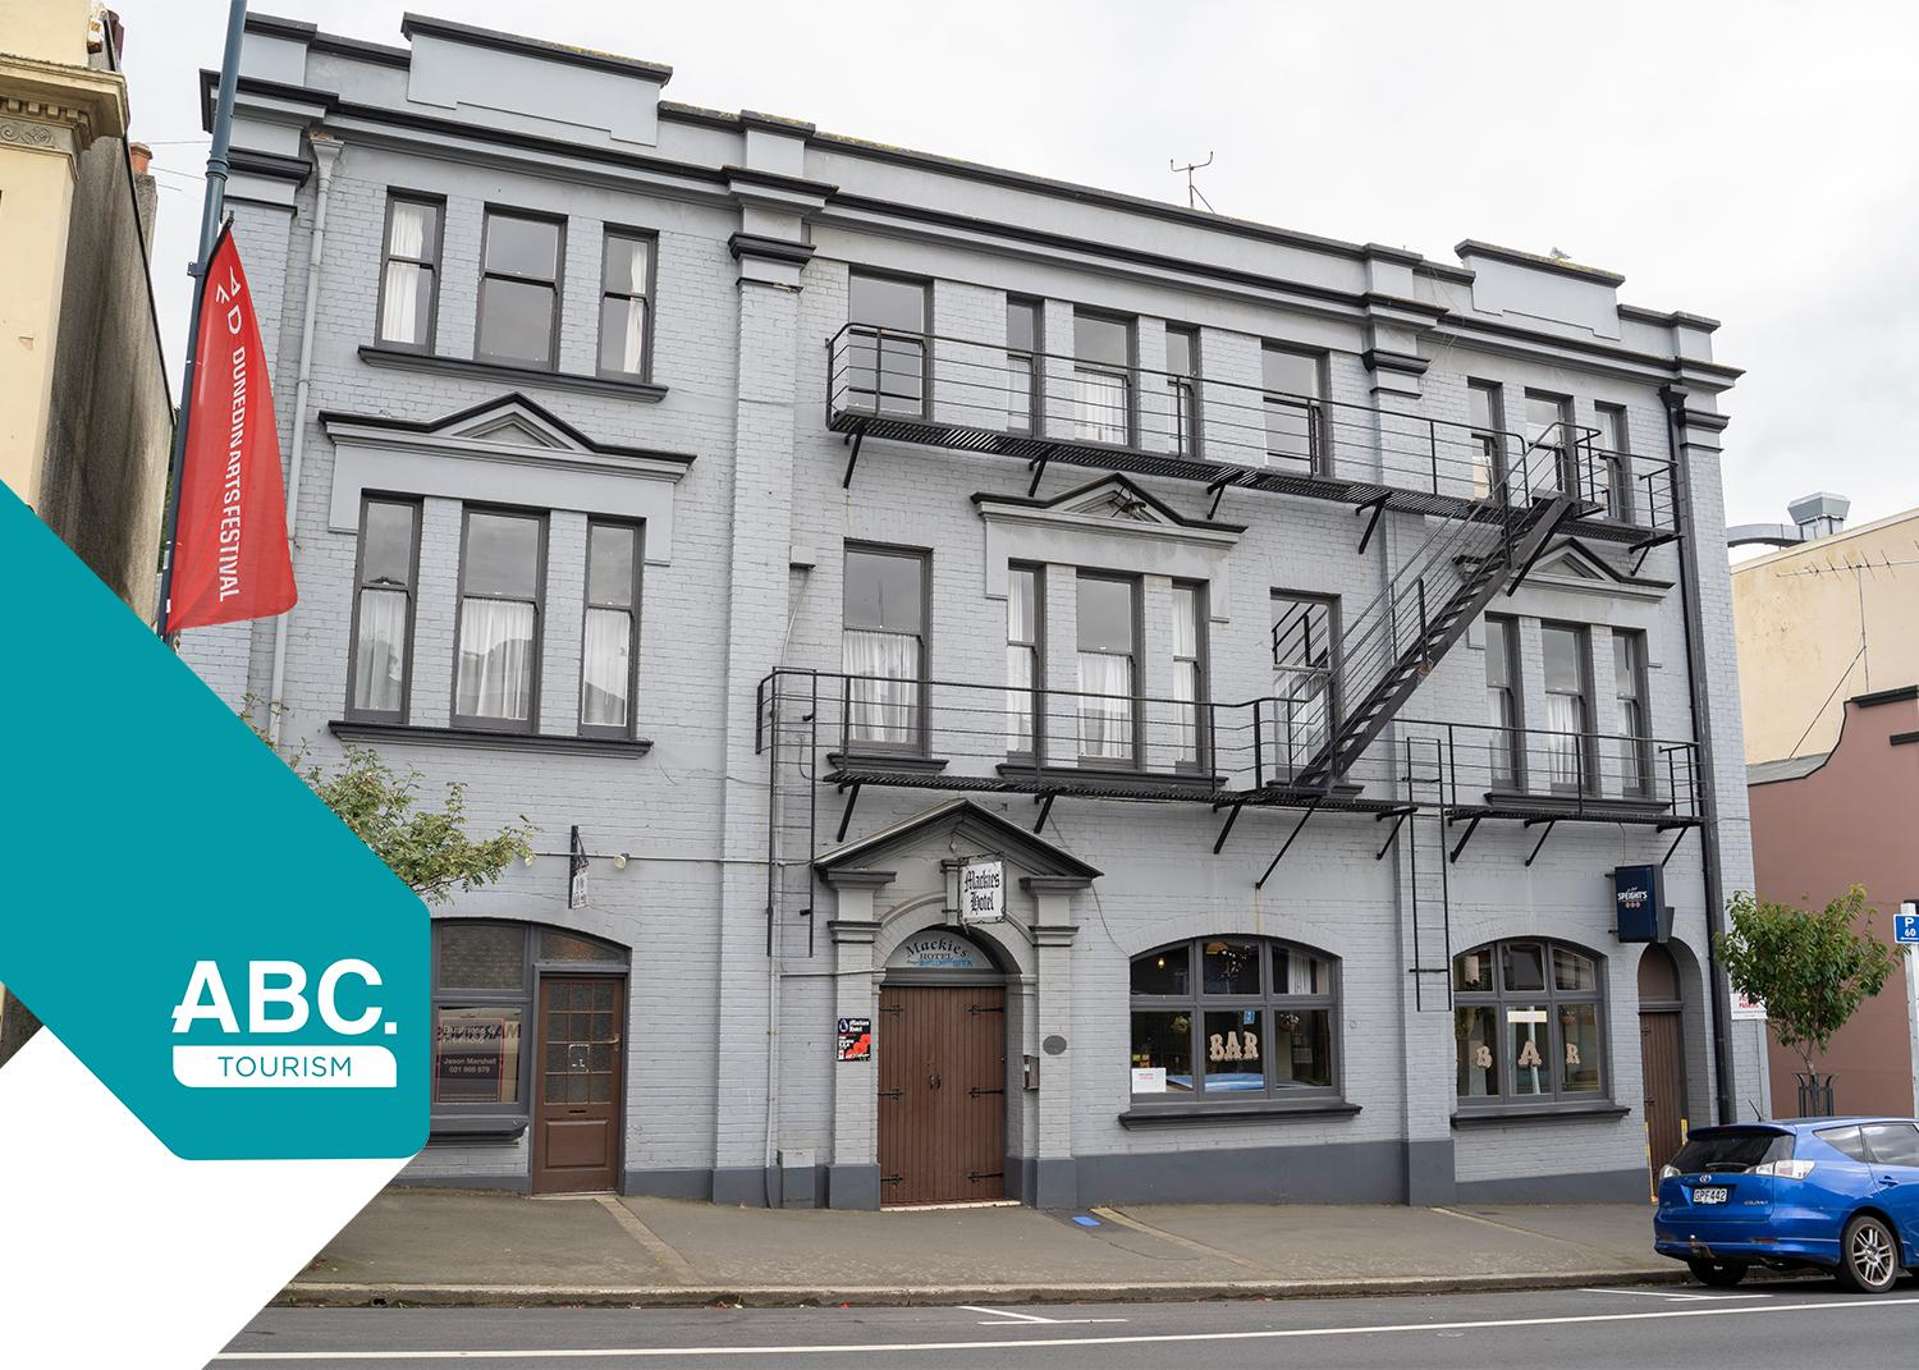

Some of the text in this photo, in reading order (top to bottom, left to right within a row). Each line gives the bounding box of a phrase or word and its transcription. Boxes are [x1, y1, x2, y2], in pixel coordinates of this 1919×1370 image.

[1904, 917, 1915, 928] P
[1904, 928, 1917, 937] 60
[1209, 1031, 1260, 1062] BAR
[1694, 1189, 1727, 1201] GPF442
